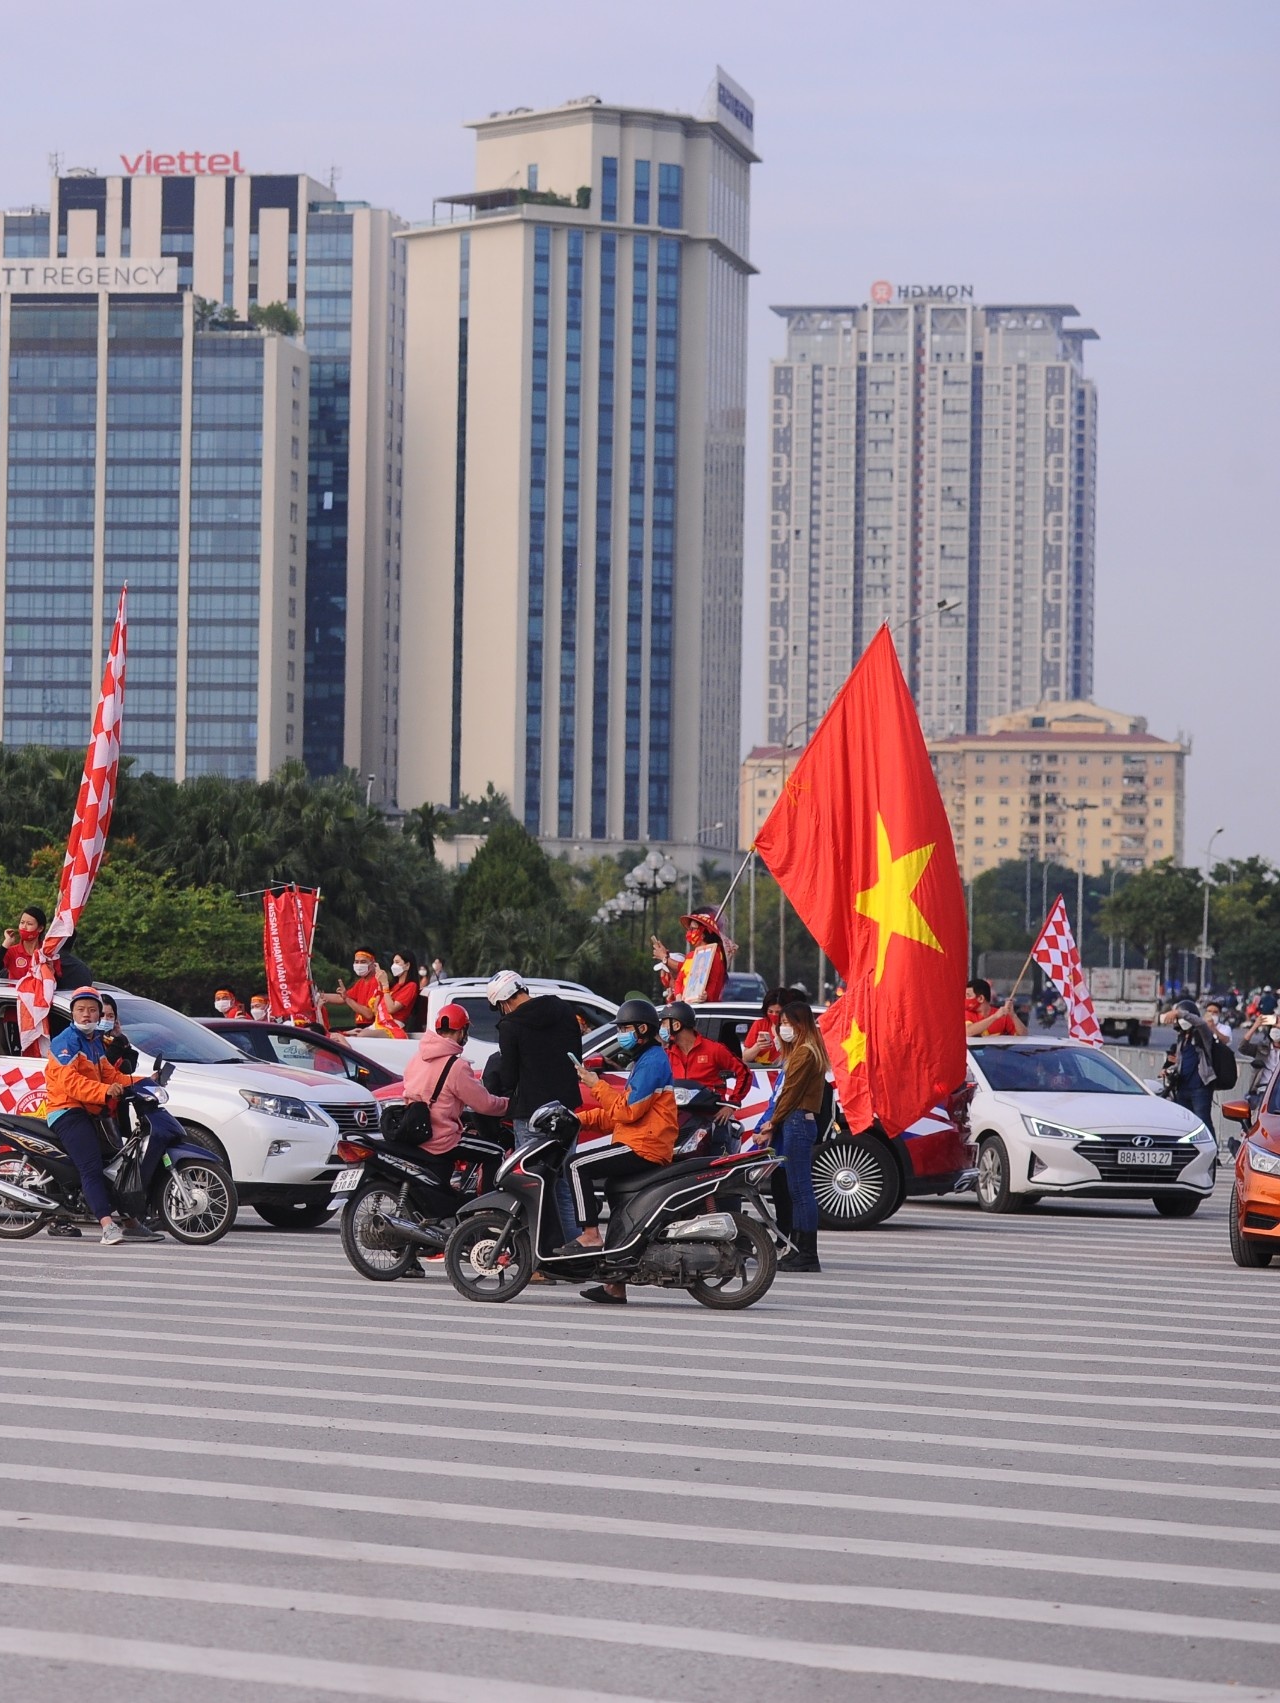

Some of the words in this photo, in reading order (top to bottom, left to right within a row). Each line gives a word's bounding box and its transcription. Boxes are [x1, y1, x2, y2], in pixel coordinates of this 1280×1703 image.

[120, 150, 245, 174] viettel
[43, 266, 166, 286] REGENCY
[268, 902, 279, 936] NISSAN
[1120, 1151, 1171, 1164] 88A-313.27
